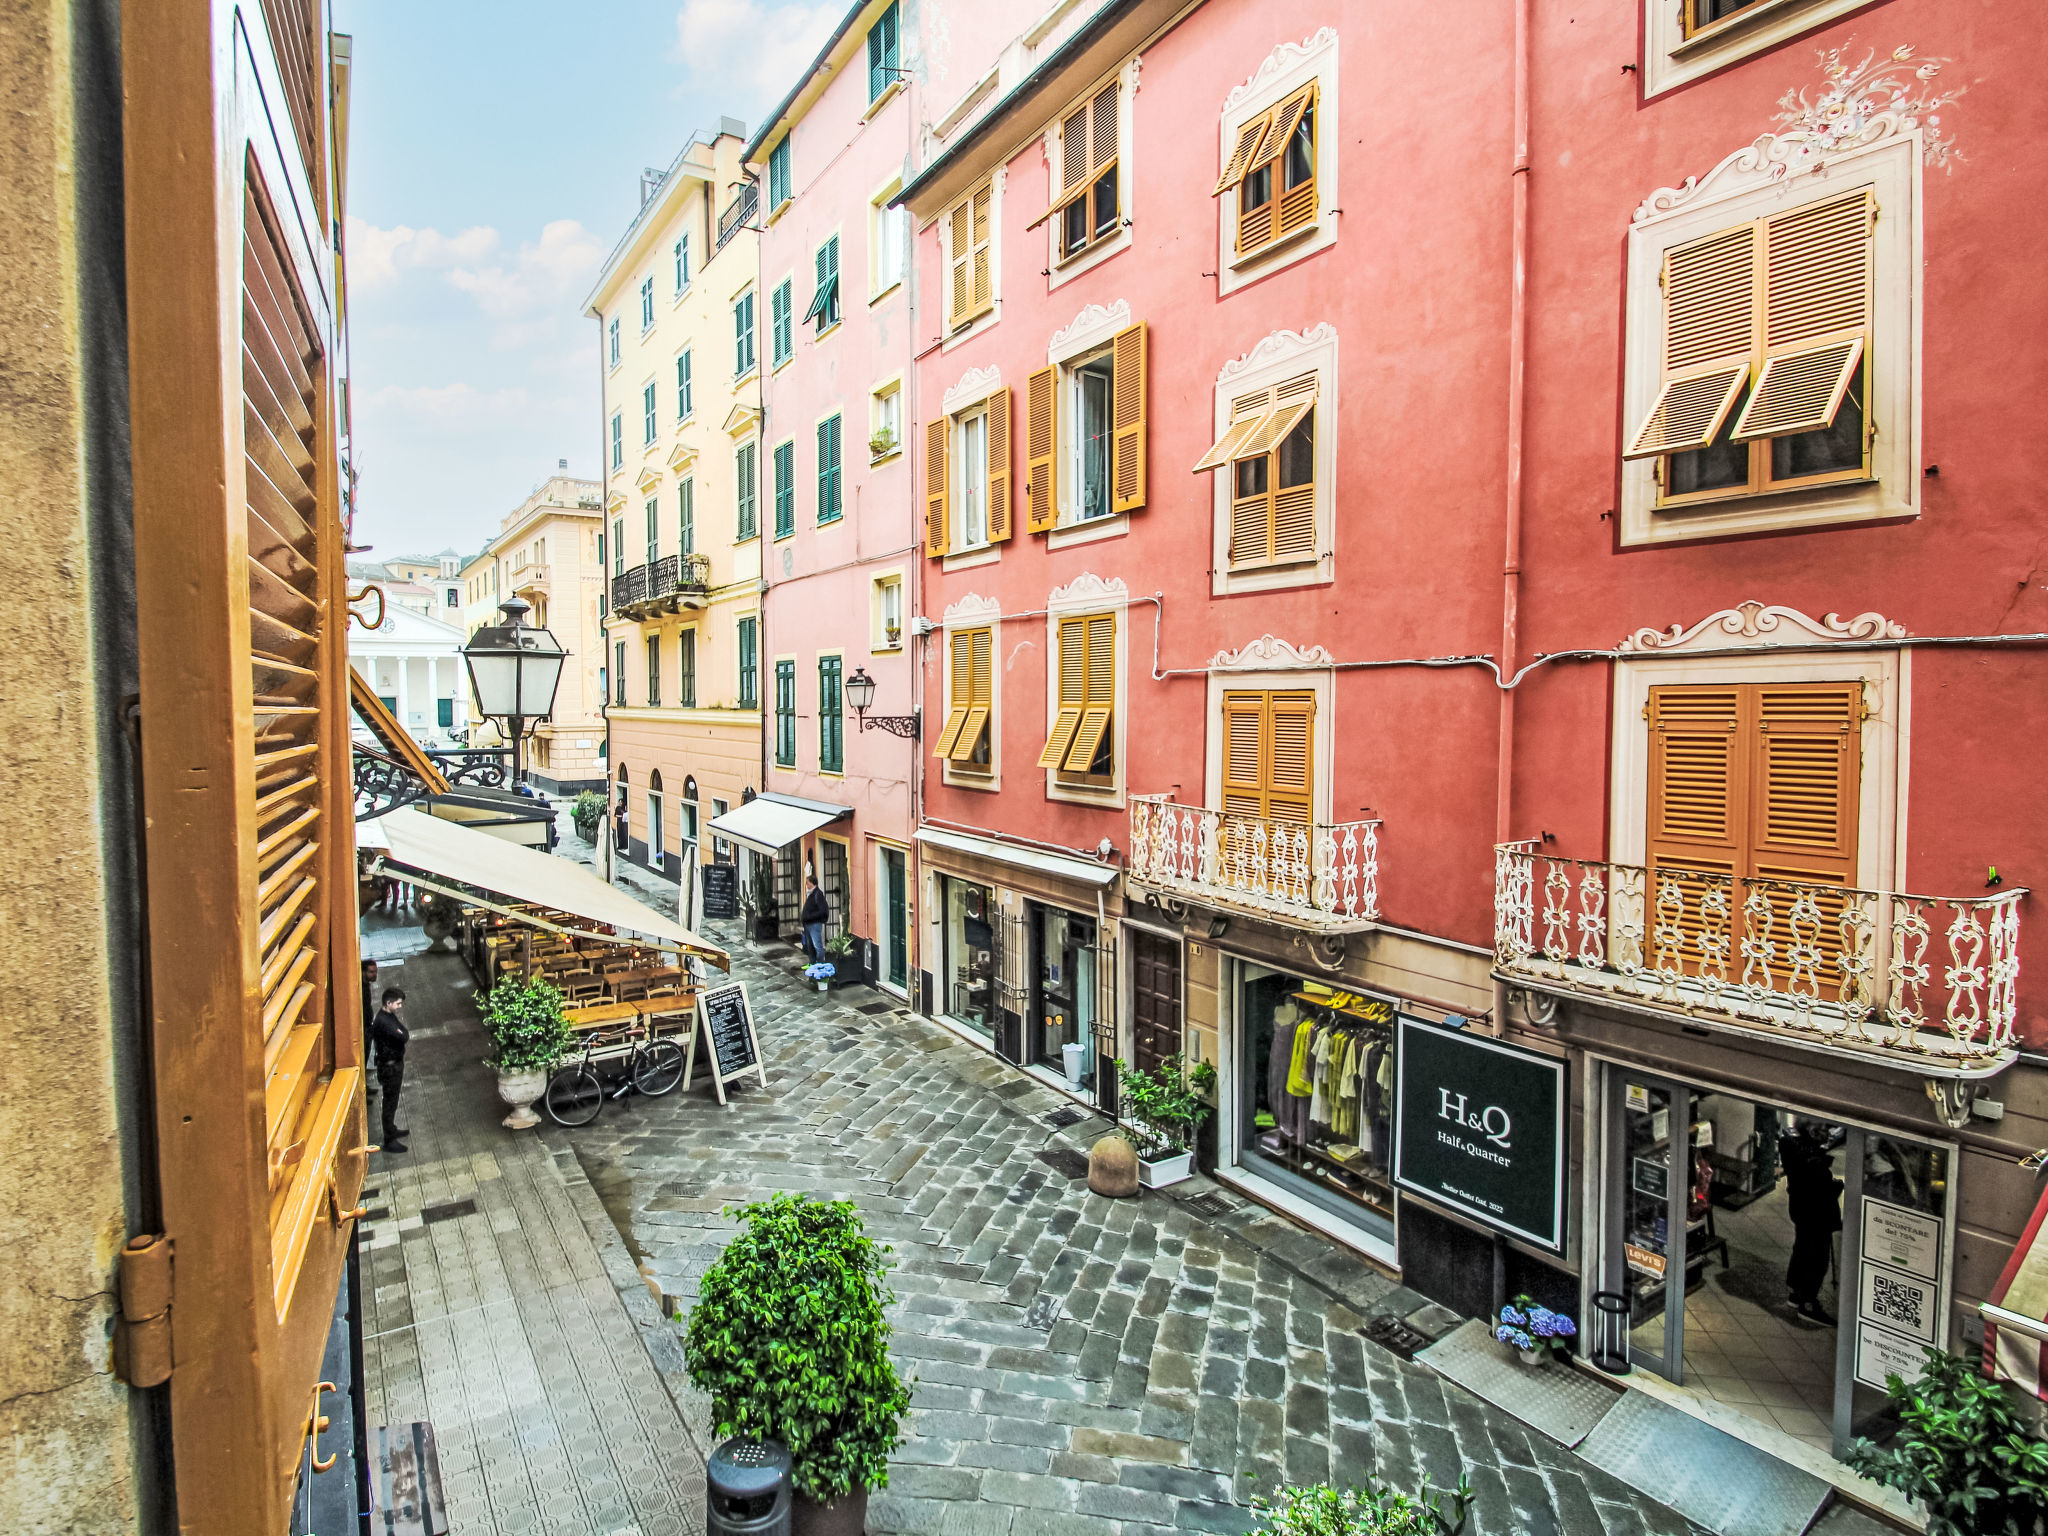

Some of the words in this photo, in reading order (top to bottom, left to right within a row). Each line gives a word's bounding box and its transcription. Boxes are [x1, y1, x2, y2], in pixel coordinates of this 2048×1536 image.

[1438, 1087, 1511, 1148] H&Q
[1437, 1131, 1461, 1149] Half
[1467, 1143, 1511, 1168] Quarter
[1489, 1201, 1503, 1214] 2022
[1873, 1216, 1883, 1224] da
[1885, 1219, 1930, 1238] SCONTARE
[1885, 1228, 1897, 1236] del
[1900, 1232, 1916, 1242] 75%
[1863, 1336, 1872, 1345] be
[1880, 1351, 1890, 1359] by
[1892, 1355, 1909, 1366] 75%
